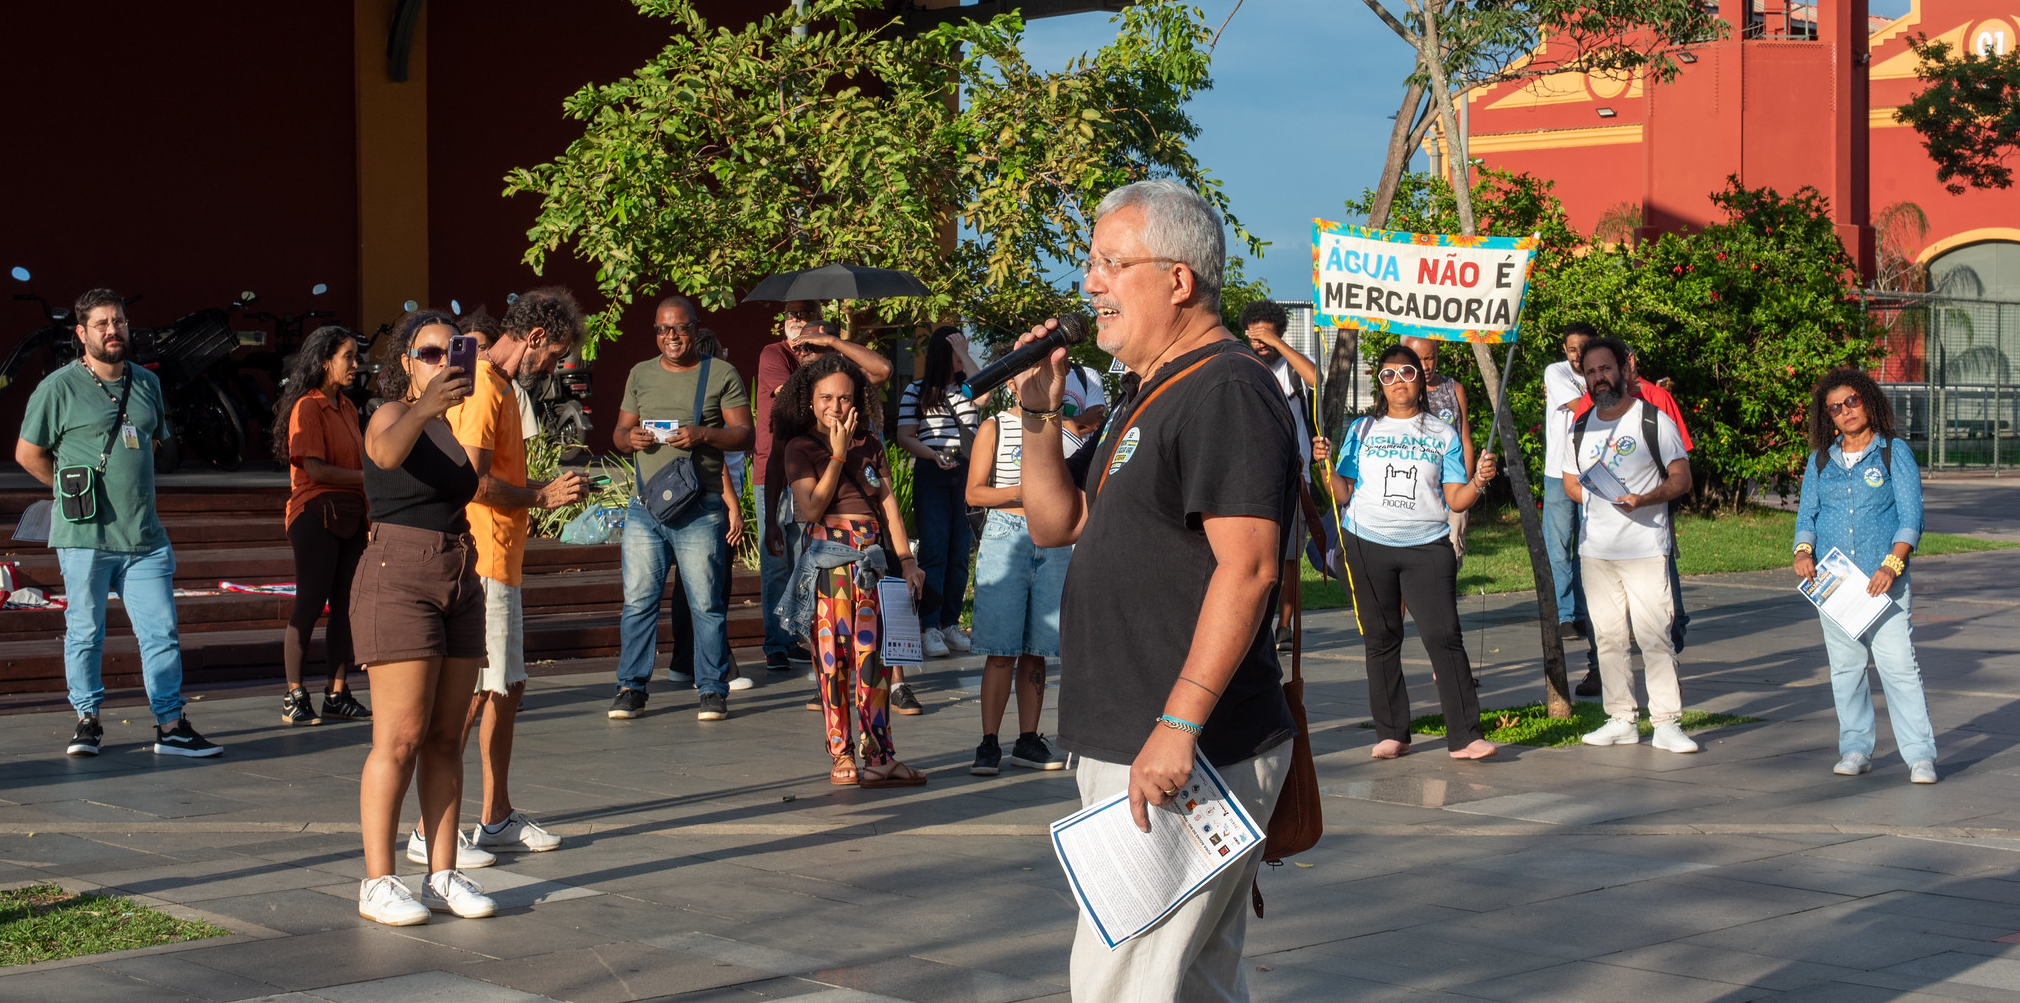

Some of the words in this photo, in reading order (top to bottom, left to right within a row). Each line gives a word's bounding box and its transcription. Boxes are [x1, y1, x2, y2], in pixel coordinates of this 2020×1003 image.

[1977, 31, 2004, 56] 01
[1325, 239, 1400, 282] ÁGUA
[1417, 252, 1480, 288] NÃO
[1495, 255, 1515, 289] É
[1324, 282, 1511, 325] MERCADORIA
[1363, 433, 1443, 449] VIGILÂNCIA
[1366, 449, 1438, 465] POPULAR
[1382, 499, 1416, 511] FIOCRUZ
